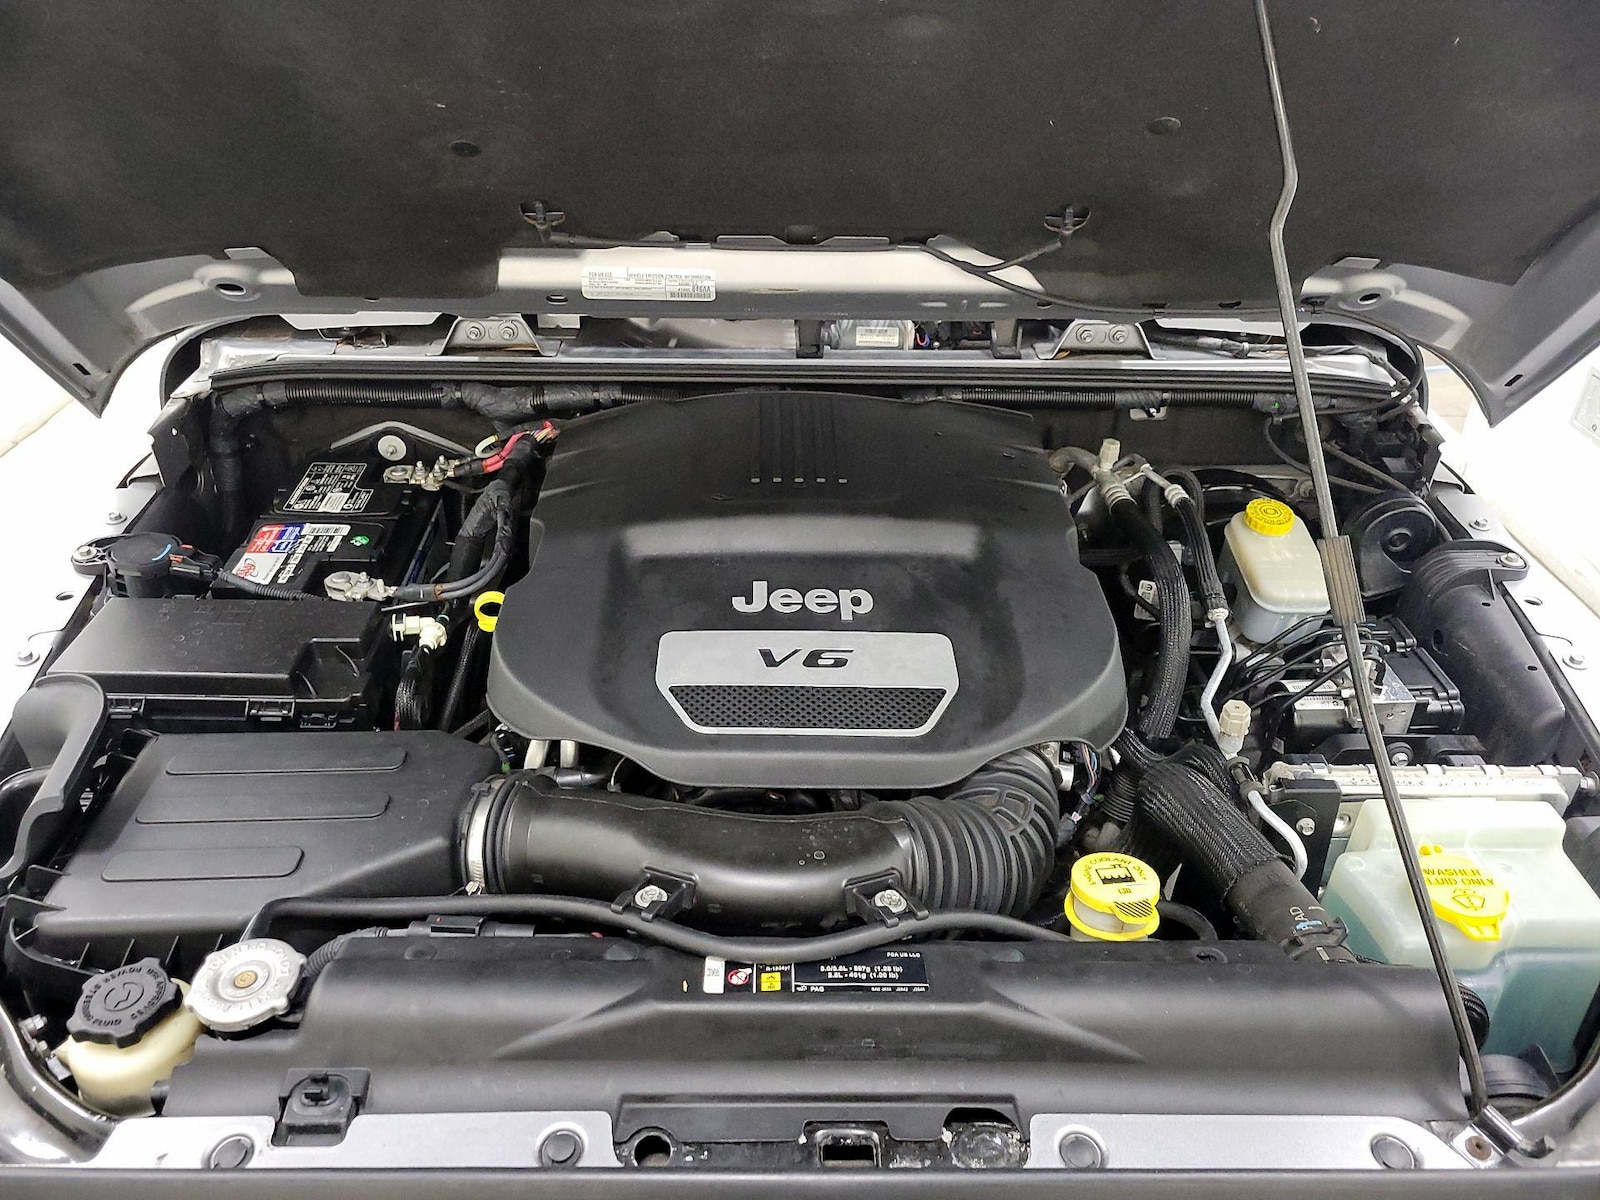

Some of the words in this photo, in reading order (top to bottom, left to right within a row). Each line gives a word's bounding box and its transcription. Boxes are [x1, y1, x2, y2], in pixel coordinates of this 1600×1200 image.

[731, 580, 874, 621] Jeep
[757, 648, 854, 668] V6
[1089, 857, 1132, 865] COOLANT
[1422, 867, 1482, 877] WASHER
[1426, 877, 1458, 886] LUID
[1461, 877, 1495, 886] ONLY
